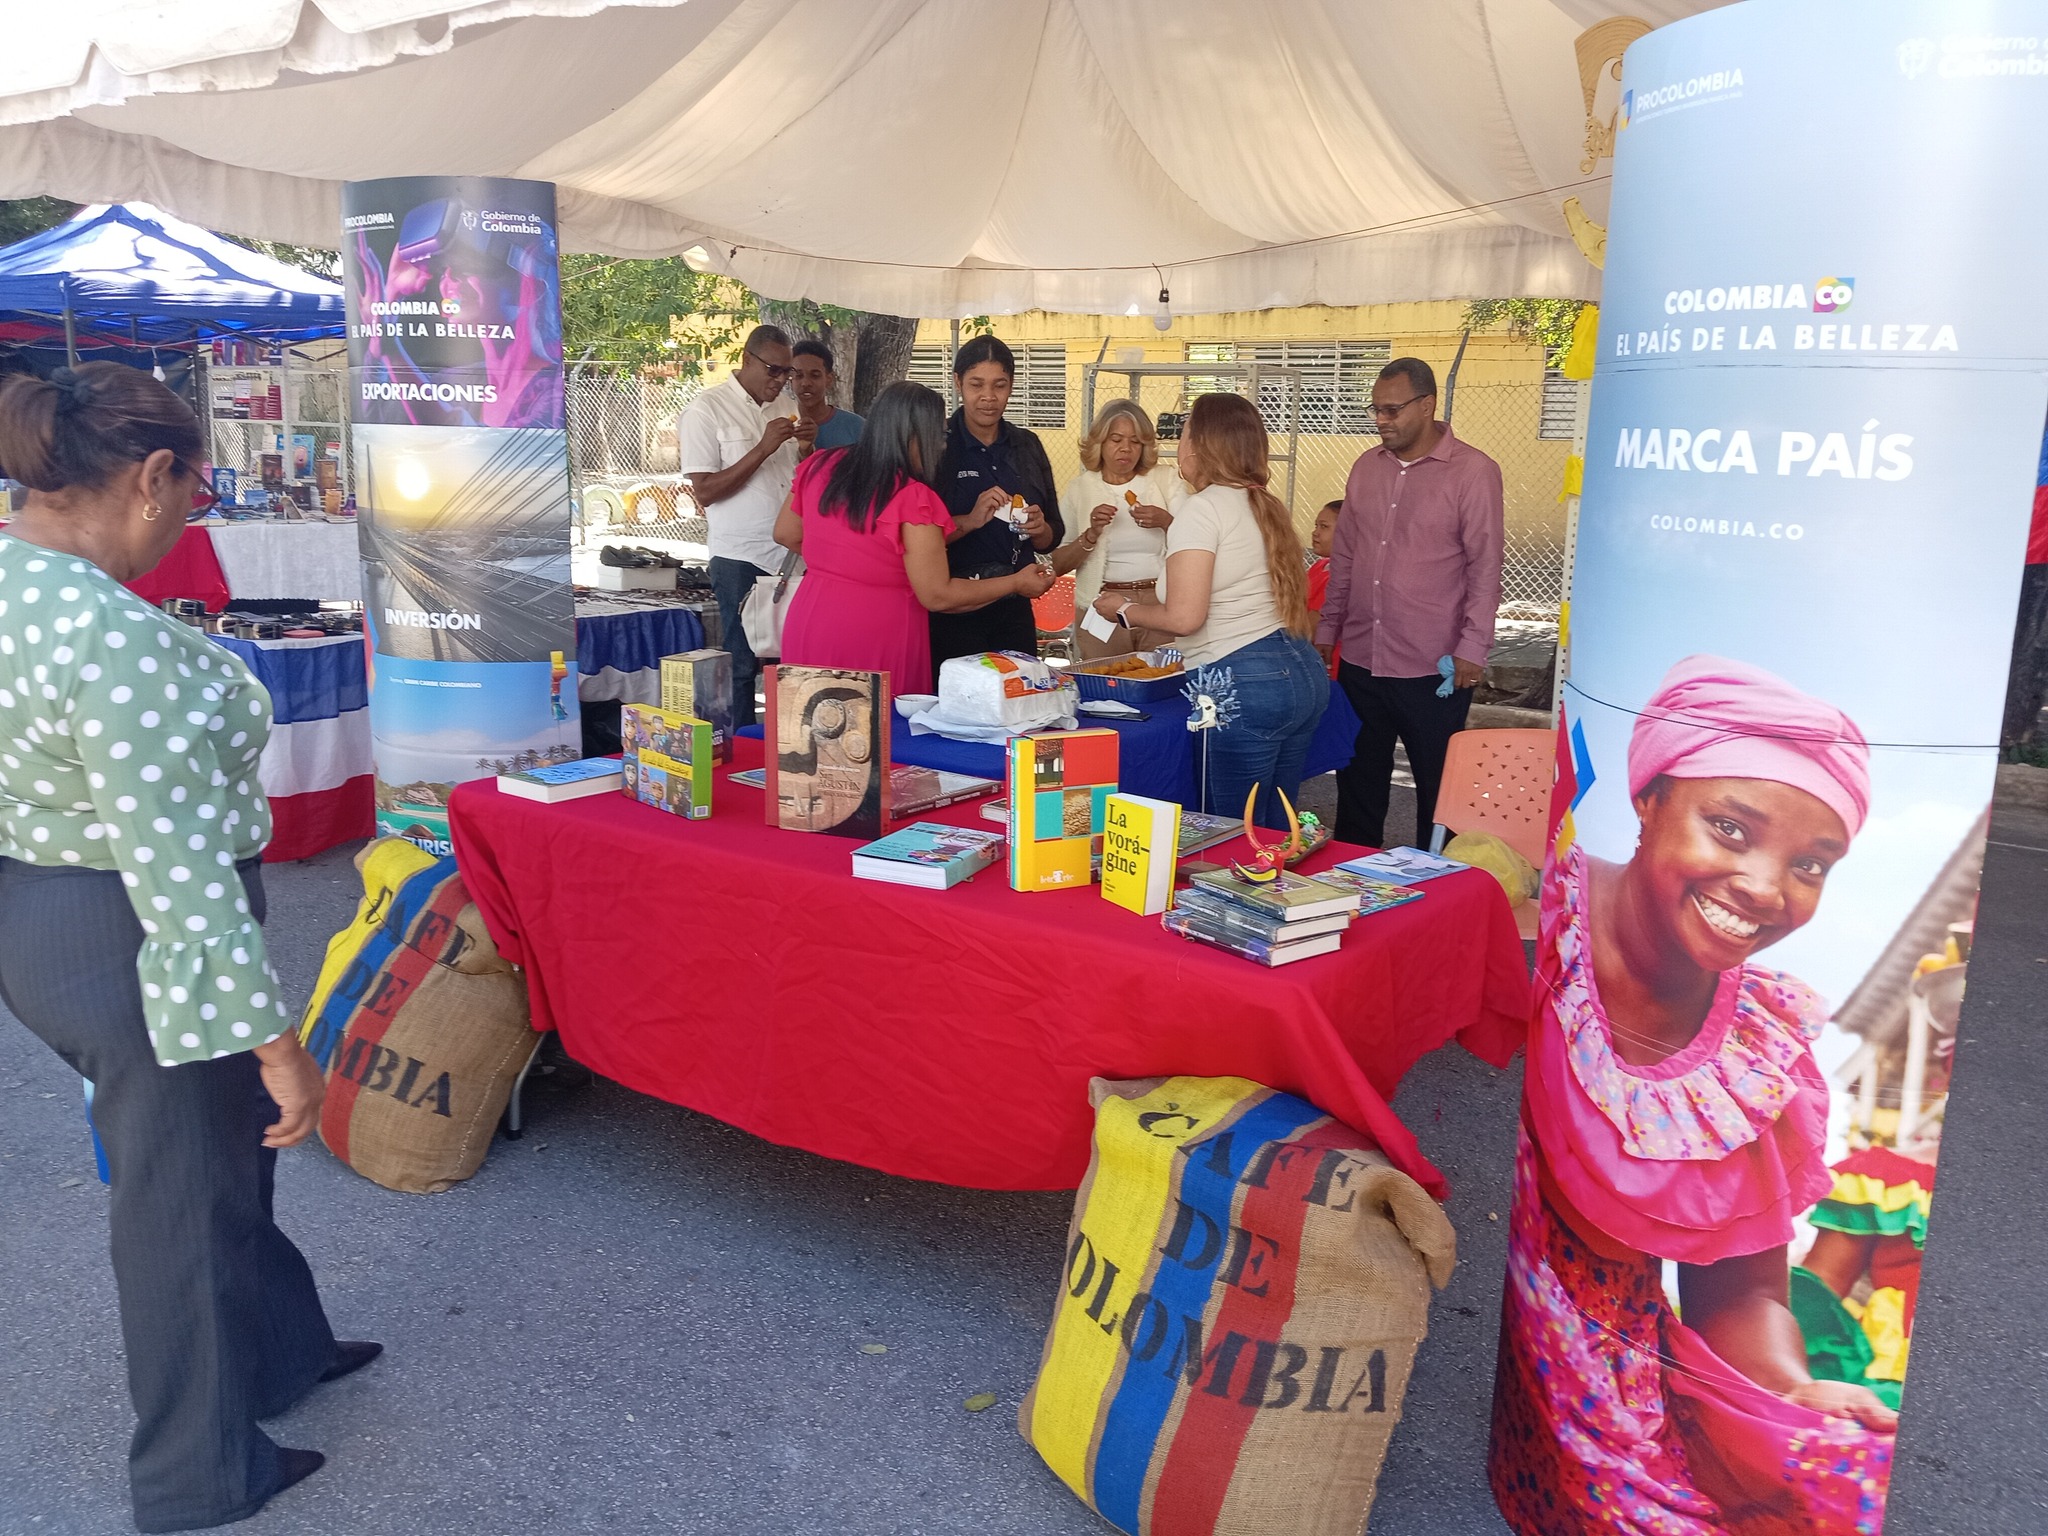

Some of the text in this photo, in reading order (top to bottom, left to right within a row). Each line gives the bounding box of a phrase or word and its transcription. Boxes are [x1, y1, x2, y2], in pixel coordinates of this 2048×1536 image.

[1937, 53, 2048, 79] Colombi
[1636, 68, 1743, 113] PROCOLOMBIA
[480, 210, 541, 222] Gobierno de
[482, 221, 542, 235] Colombia
[370, 301, 440, 316] COLOMBIA
[1664, 284, 1808, 315] COLOMBIA
[352, 319, 515, 340] EL PAÍS DE LA BELLEZA
[1616, 323, 1960, 356] EL PAÍS DE LA BELLEZA
[361, 383, 498, 403] EXPORTACIONES
[1614, 417, 1915, 482] MARCA PAÍS
[1650, 514, 1804, 541] COLOMBIA.CO
[384, 607, 481, 631] INVERSIÓN
[1108, 803, 1127, 828] La
[1107, 830, 1150, 855] vorá-
[1105, 850, 1137, 876] gine
[336, 958, 409, 1017] DE
[1138, 1112, 1372, 1213] CAFE
[1159, 1196, 1280, 1298] DE
[1067, 1231, 1387, 1413] OLOMBIA
